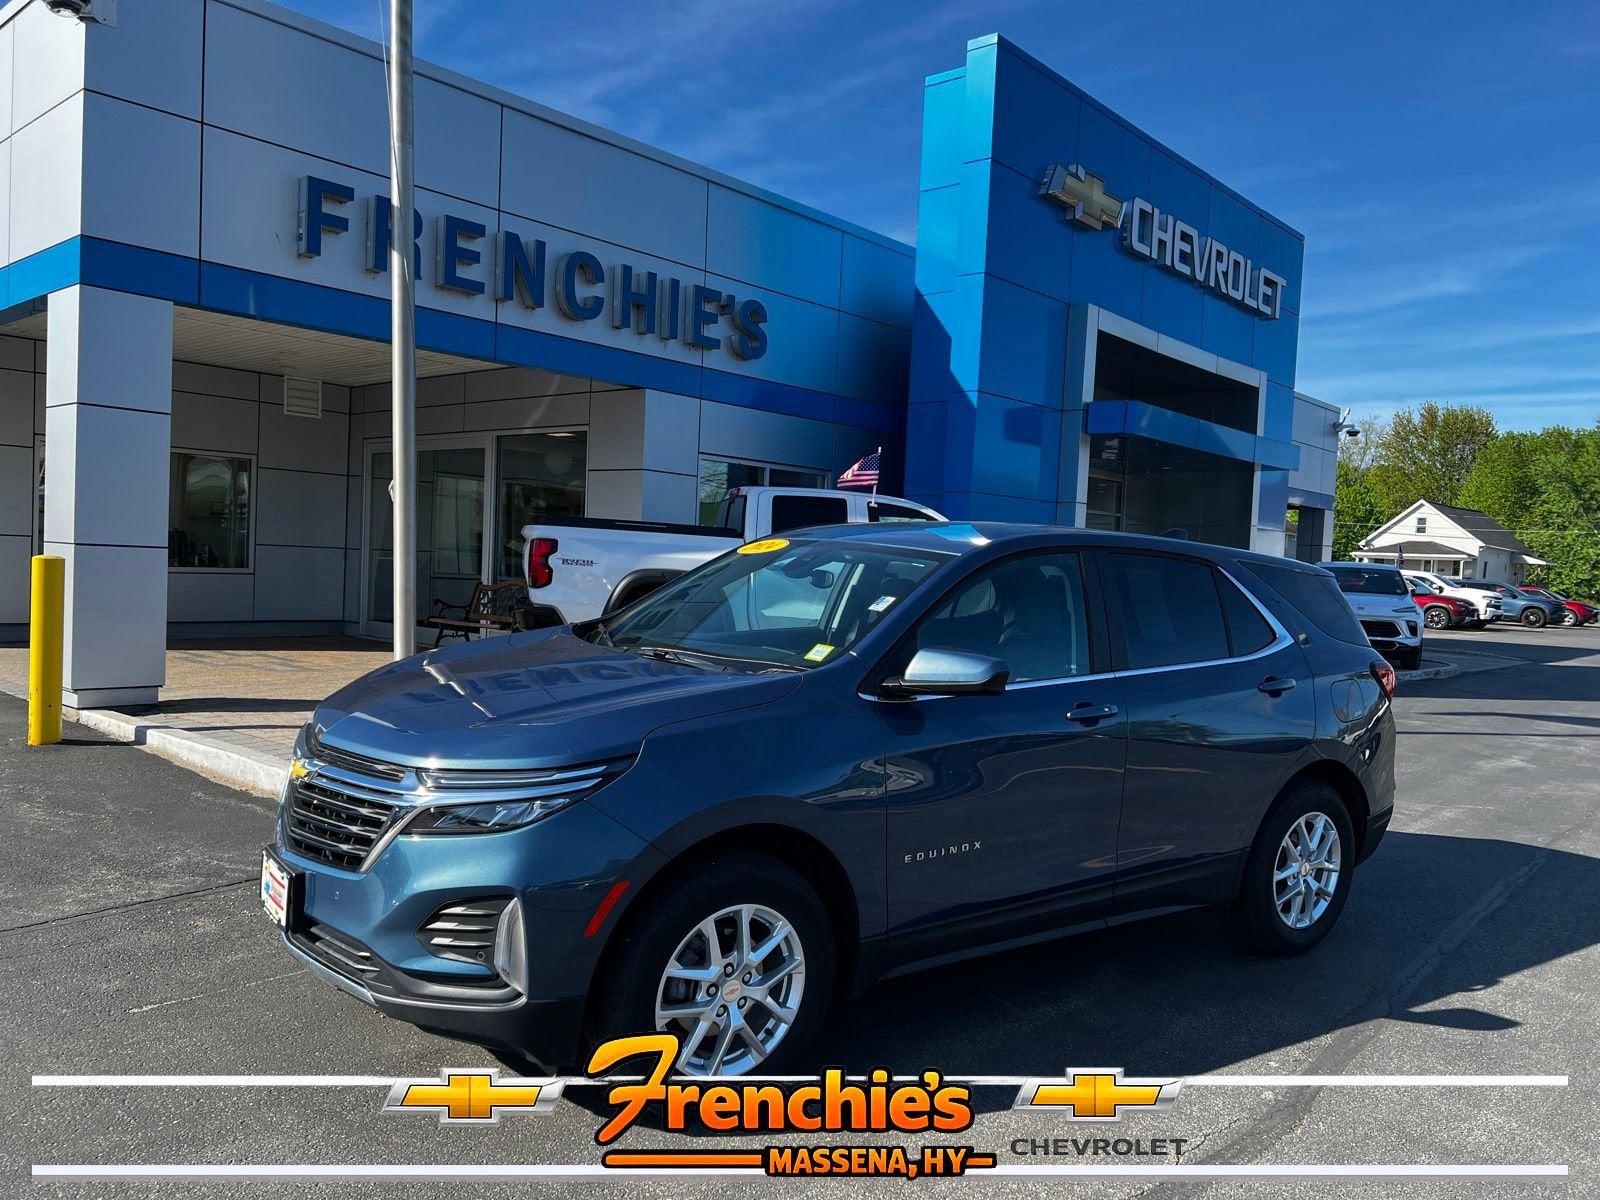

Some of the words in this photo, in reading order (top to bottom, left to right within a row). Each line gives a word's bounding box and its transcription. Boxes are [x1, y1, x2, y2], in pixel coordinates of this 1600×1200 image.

[299, 175, 768, 361] FRENCHIE'S
[1126, 196, 1287, 320] CHEVROLET
[904, 841, 982, 864] EQUINOX
